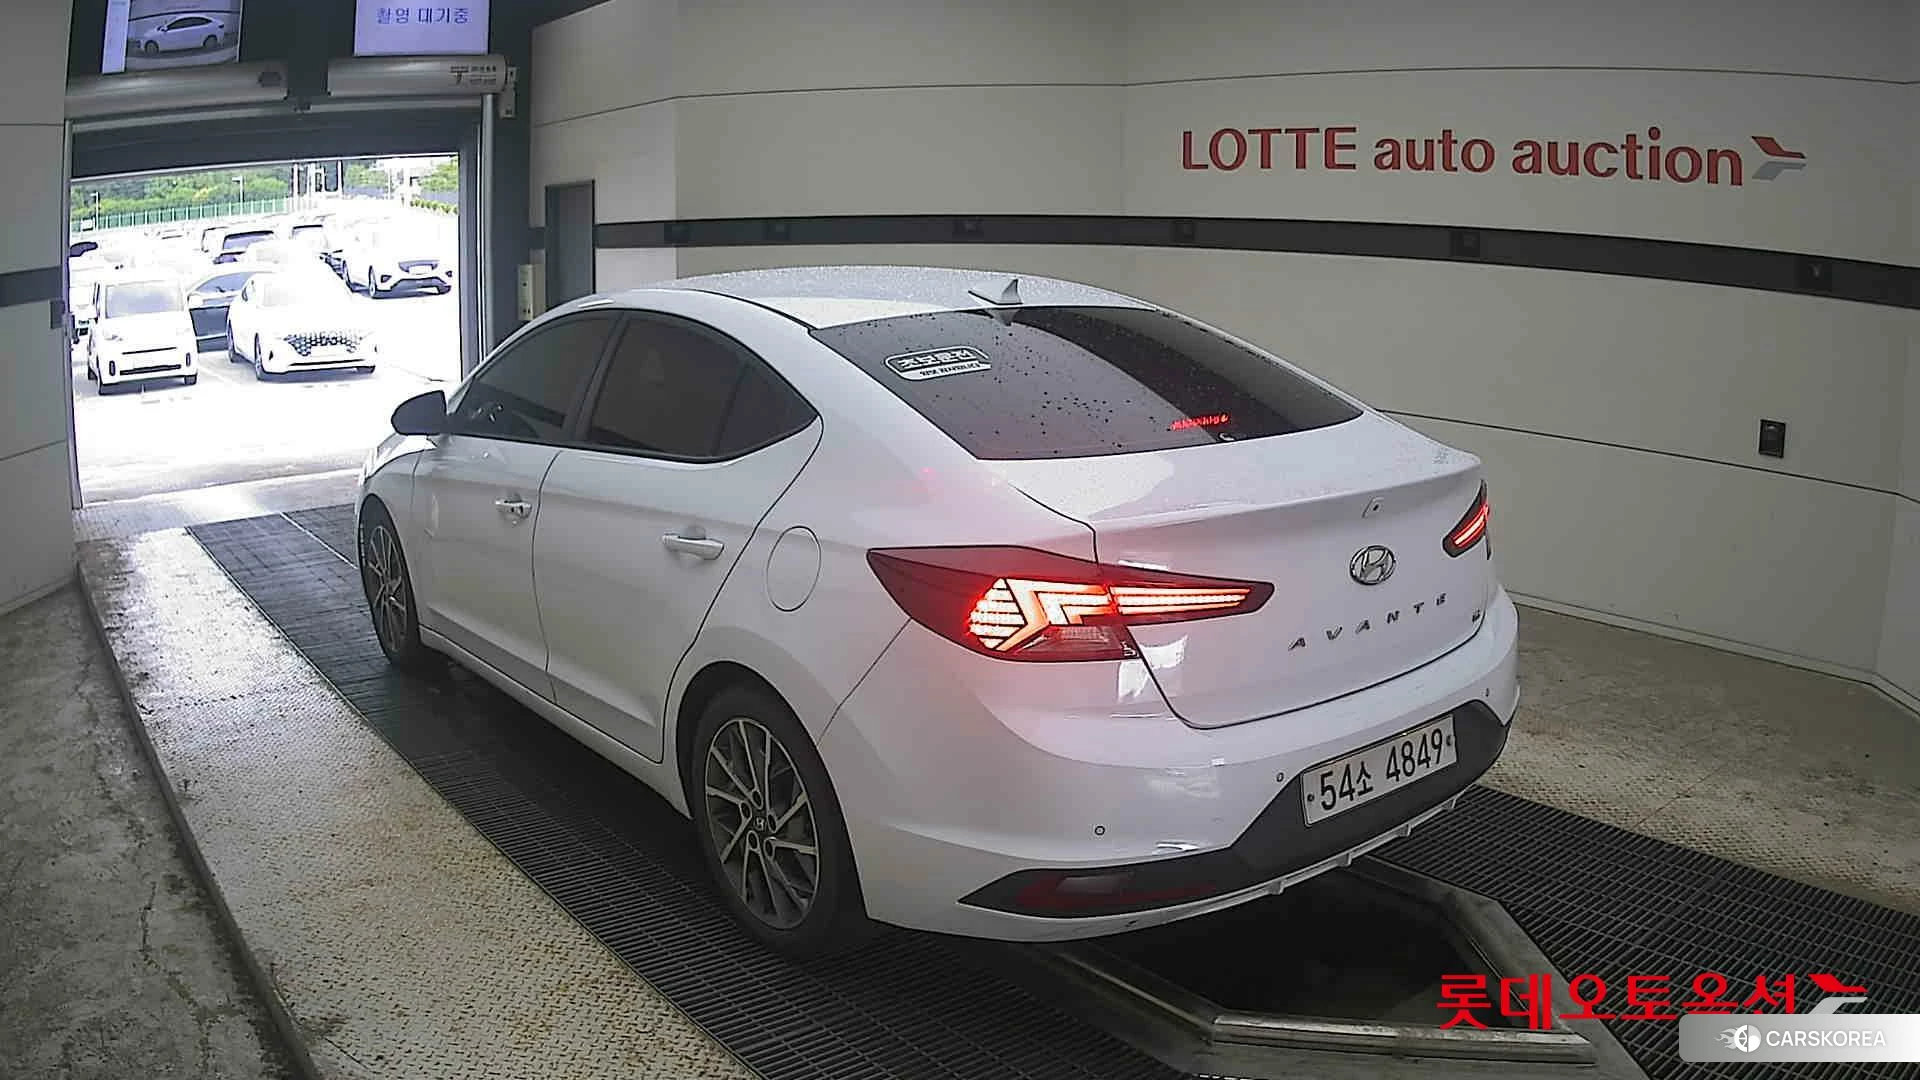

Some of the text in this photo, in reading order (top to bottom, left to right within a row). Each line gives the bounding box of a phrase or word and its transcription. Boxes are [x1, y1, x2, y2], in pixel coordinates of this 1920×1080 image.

[416, 7, 469, 24] 대기중
[1182, 126, 1743, 186] LOTTE auto auction
[1289, 592, 1448, 652] AVANTE
[1319, 727, 1443, 811] 54소 4849
